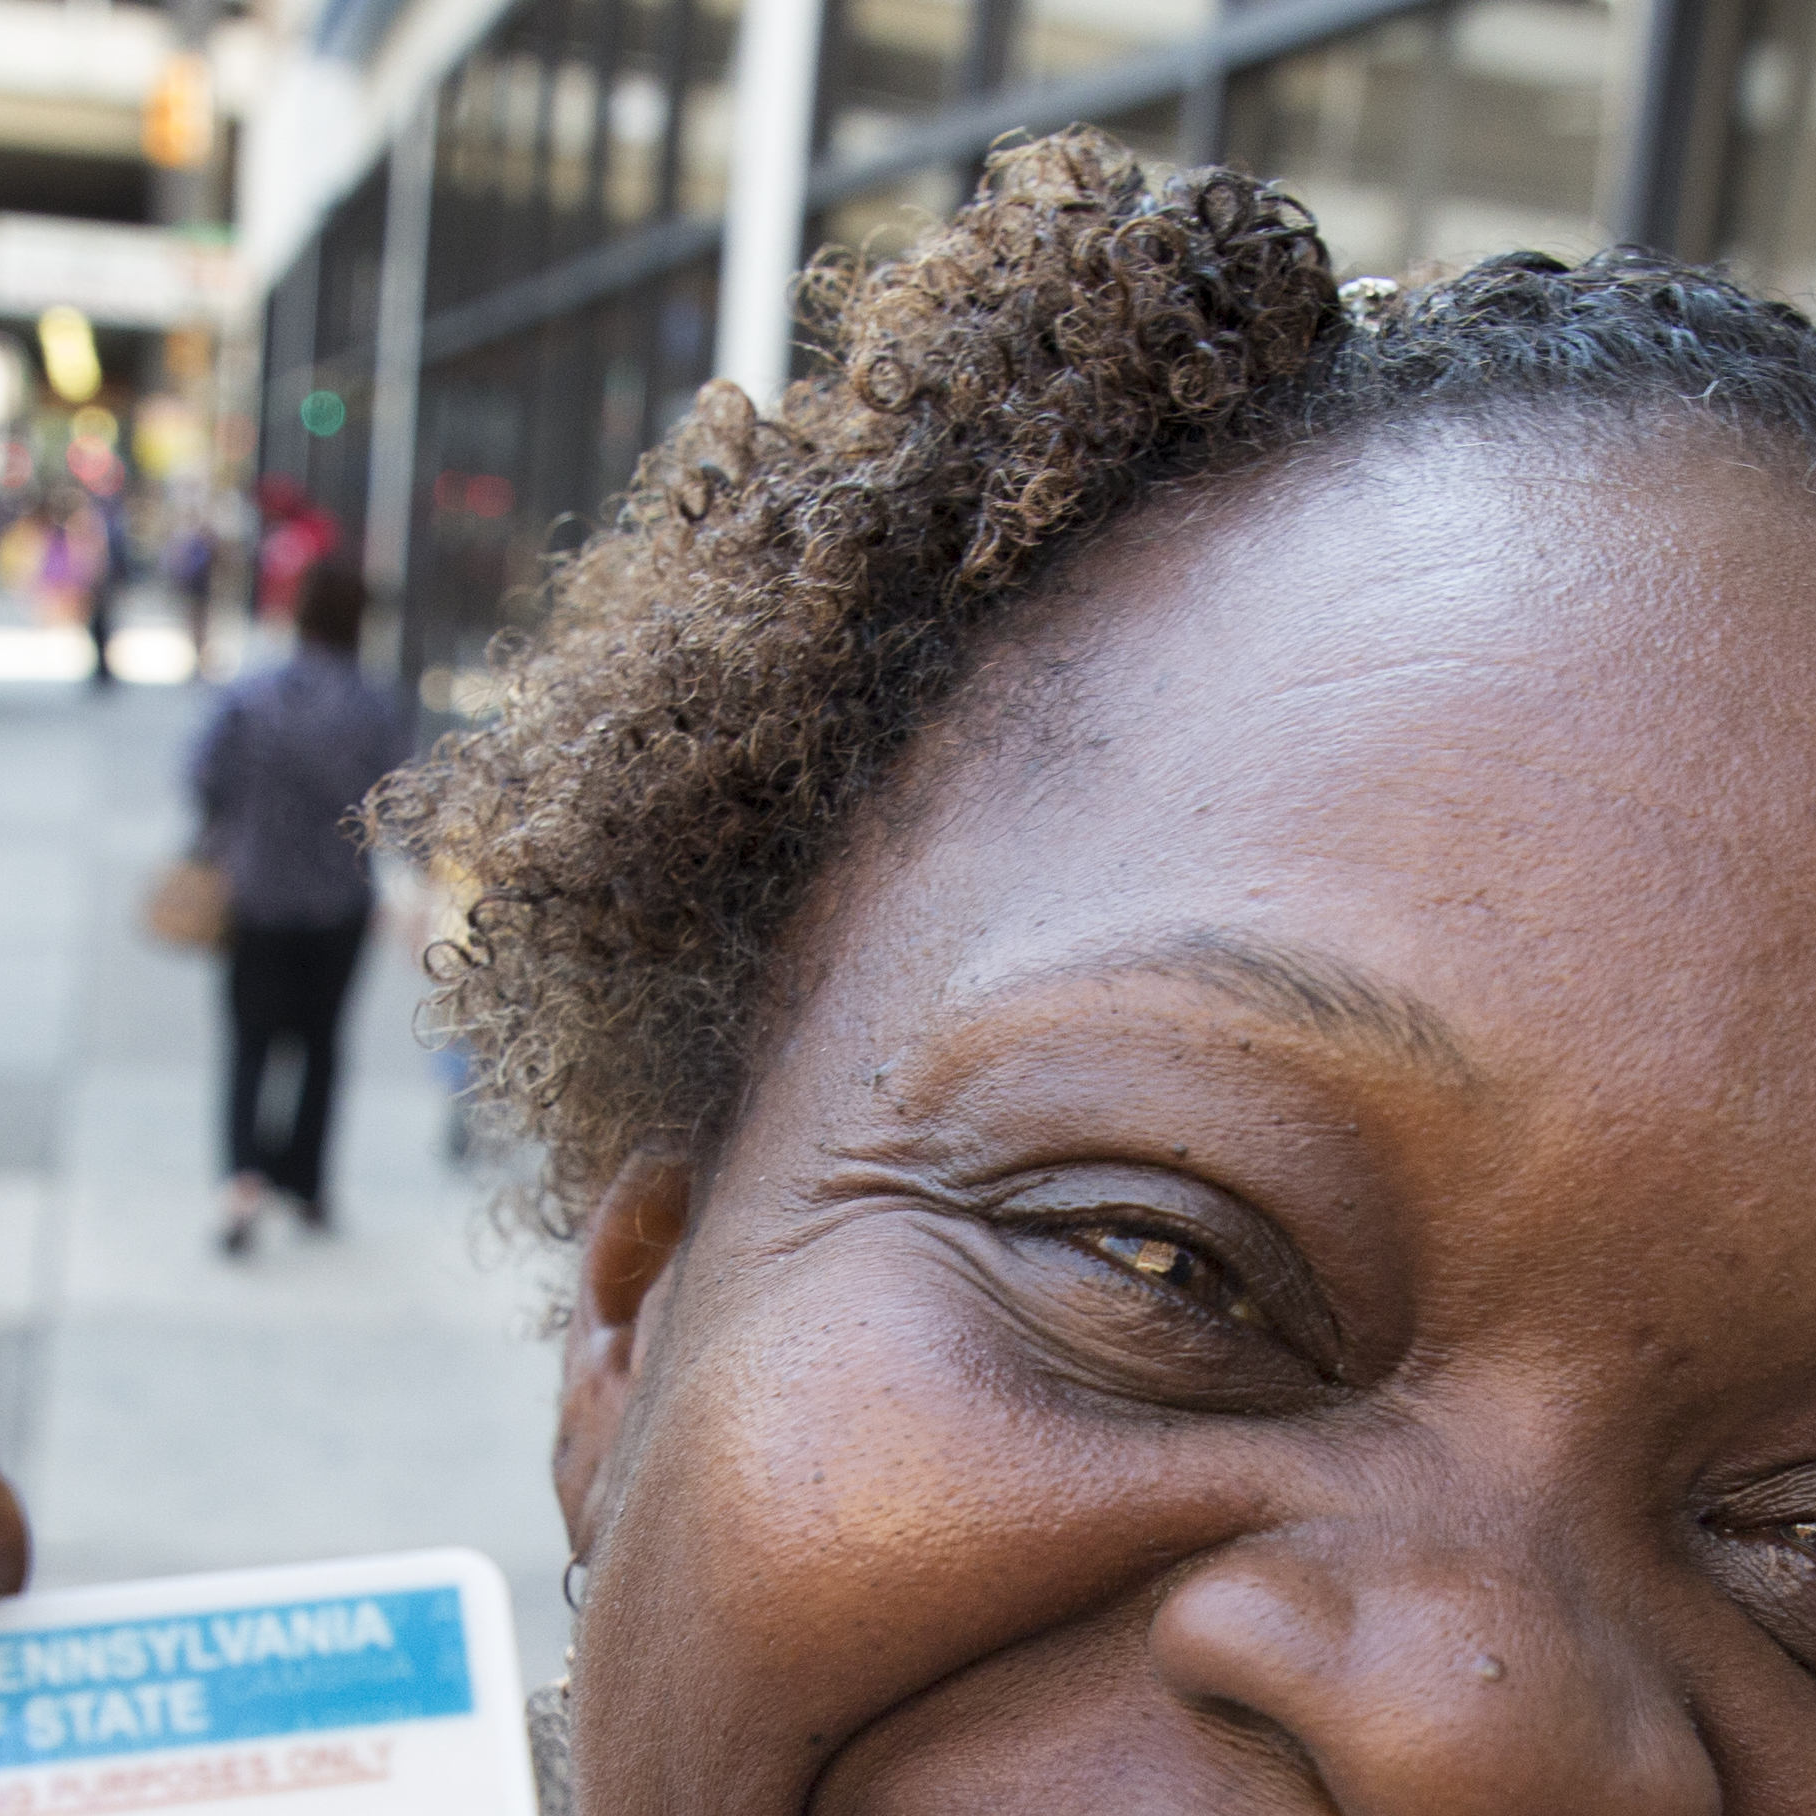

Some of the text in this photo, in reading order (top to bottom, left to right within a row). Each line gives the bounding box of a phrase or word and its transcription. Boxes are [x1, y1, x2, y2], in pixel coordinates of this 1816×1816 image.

[25, 1680, 211, 1751] STATE
[53, 1753, 271, 1812] PURPOSES
[285, 1738, 395, 1784] ONLY
